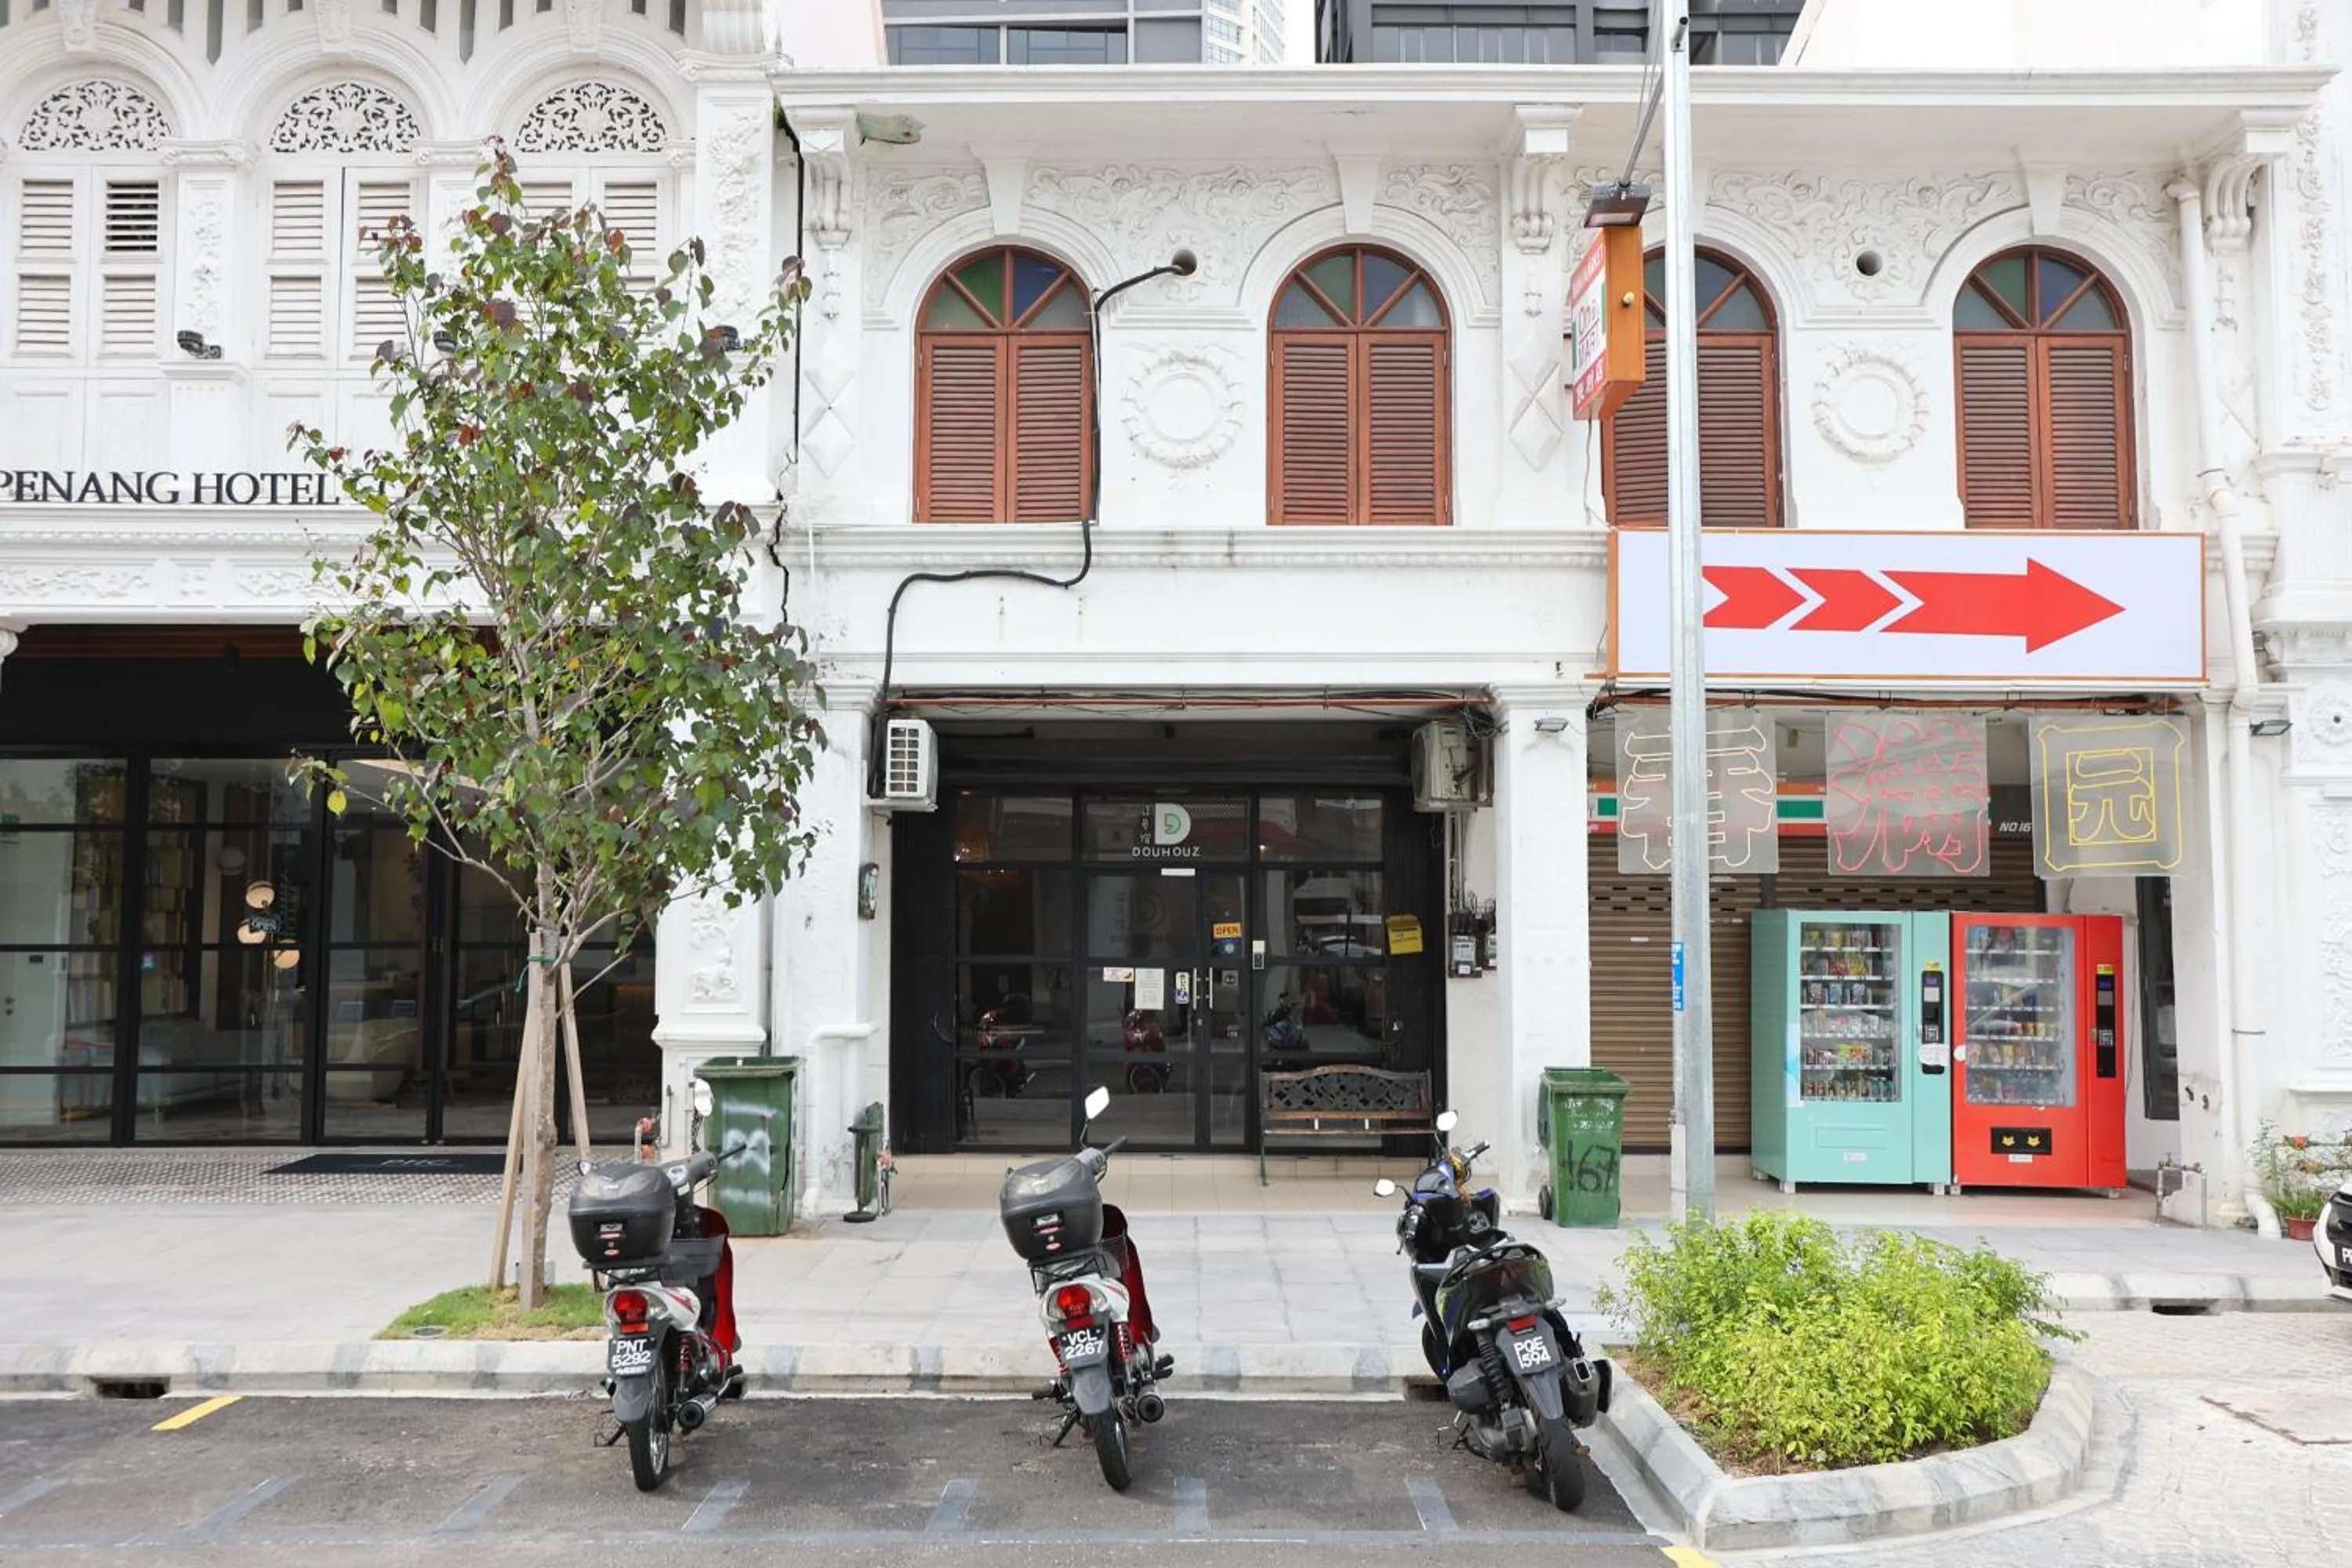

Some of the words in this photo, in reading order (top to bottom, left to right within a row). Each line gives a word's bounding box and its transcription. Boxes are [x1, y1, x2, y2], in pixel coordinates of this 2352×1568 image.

[191, 472, 339, 506] HOTEL
[1999, 822, 2017, 832] NO
[1131, 846, 1202, 857] DOUHOUZ
[1216, 926, 1240, 935] OPEN
[616, 1338, 647, 1353] PNT
[1067, 1329, 1098, 1345] VCL
[1514, 1336, 1544, 1354] PQE
[1065, 1340, 1103, 1360] 2267
[1517, 1345, 1552, 1369] 1594
[612, 1350, 652, 1368] 5292
